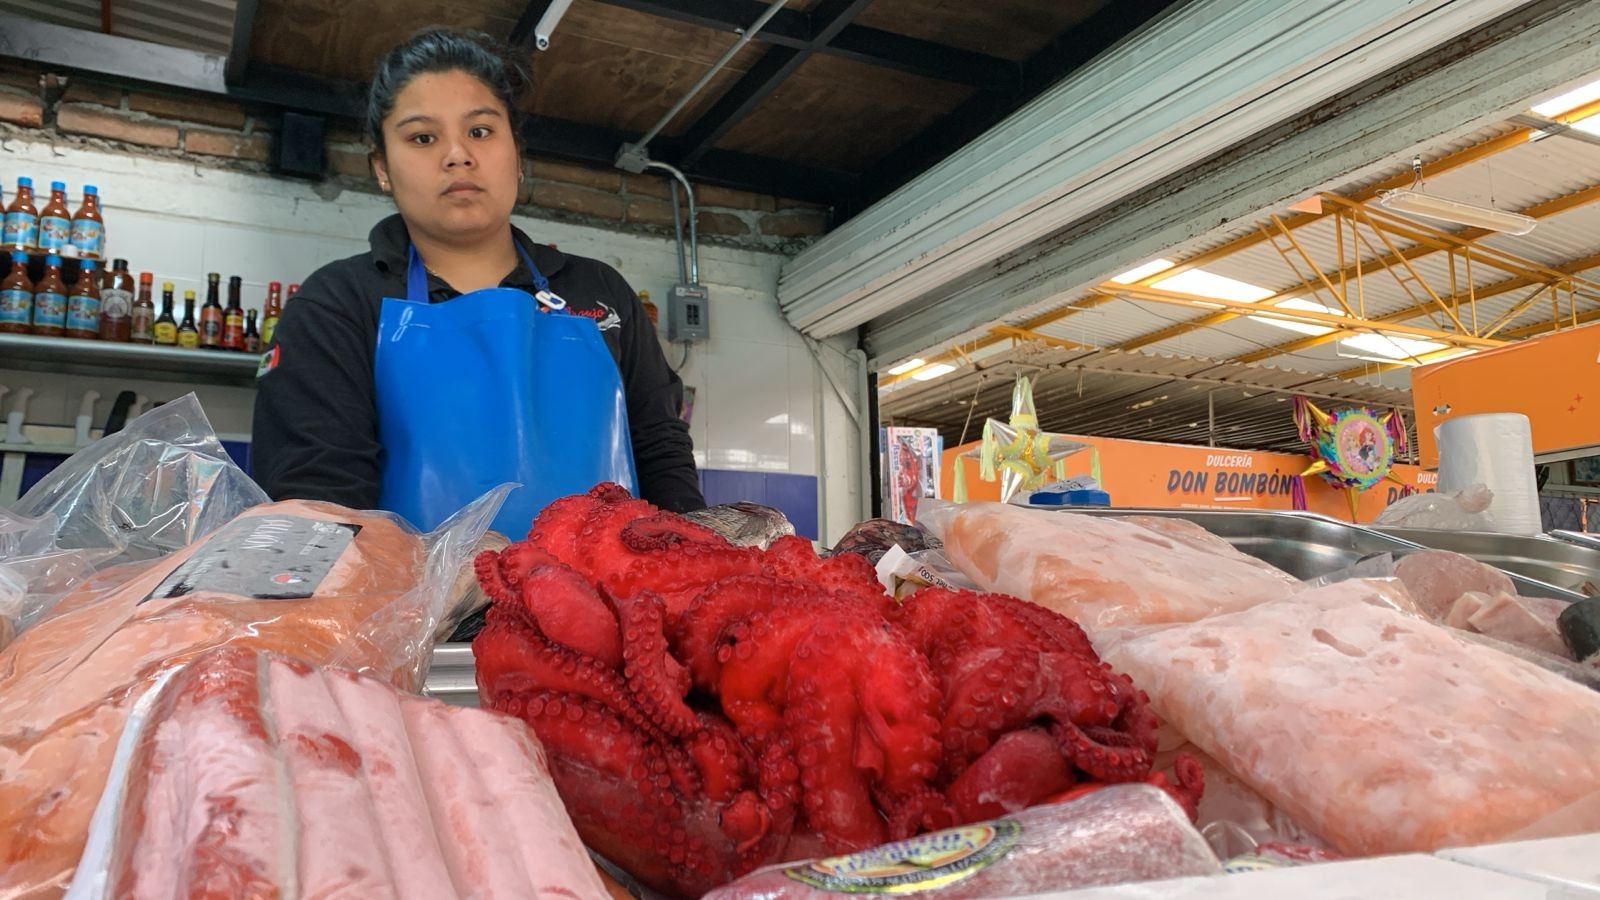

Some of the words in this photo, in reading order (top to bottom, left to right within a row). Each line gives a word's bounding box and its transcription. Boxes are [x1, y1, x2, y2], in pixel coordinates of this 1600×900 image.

[1206, 454, 1253, 468] DULCERÍA
[1167, 469, 1209, 494] DON
[1214, 468, 1293, 495] BOMBÓN
